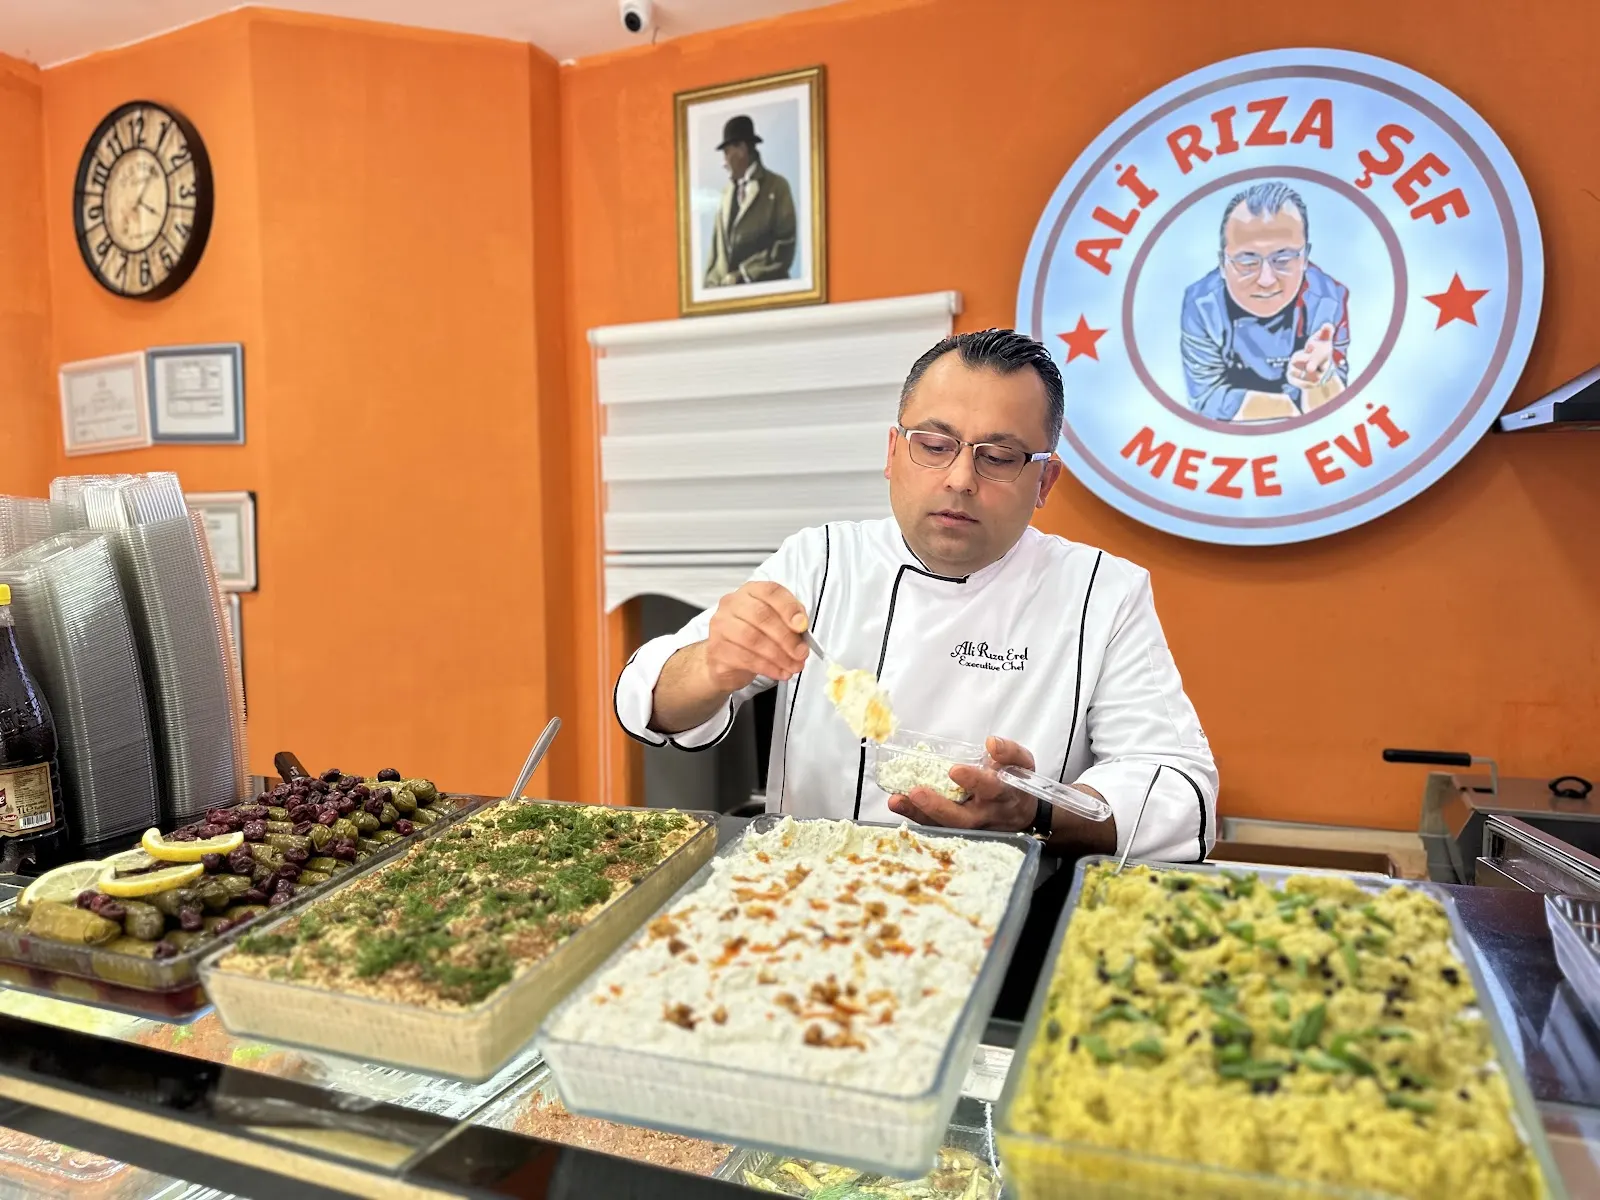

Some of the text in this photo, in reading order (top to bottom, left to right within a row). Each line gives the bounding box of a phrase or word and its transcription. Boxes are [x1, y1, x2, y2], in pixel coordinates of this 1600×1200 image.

[128, 116, 146, 148] 12
[179, 182, 197, 200] 3
[1074, 96, 1471, 275] ALİ RIZA ŞEF
[115, 252, 129, 279] 7
[1119, 402, 1410, 499] MEZE EVİ
[950, 640, 976, 658] Ali
[1006, 646, 1029, 661] Erel
[958, 655, 1025, 671] Executive Chef
